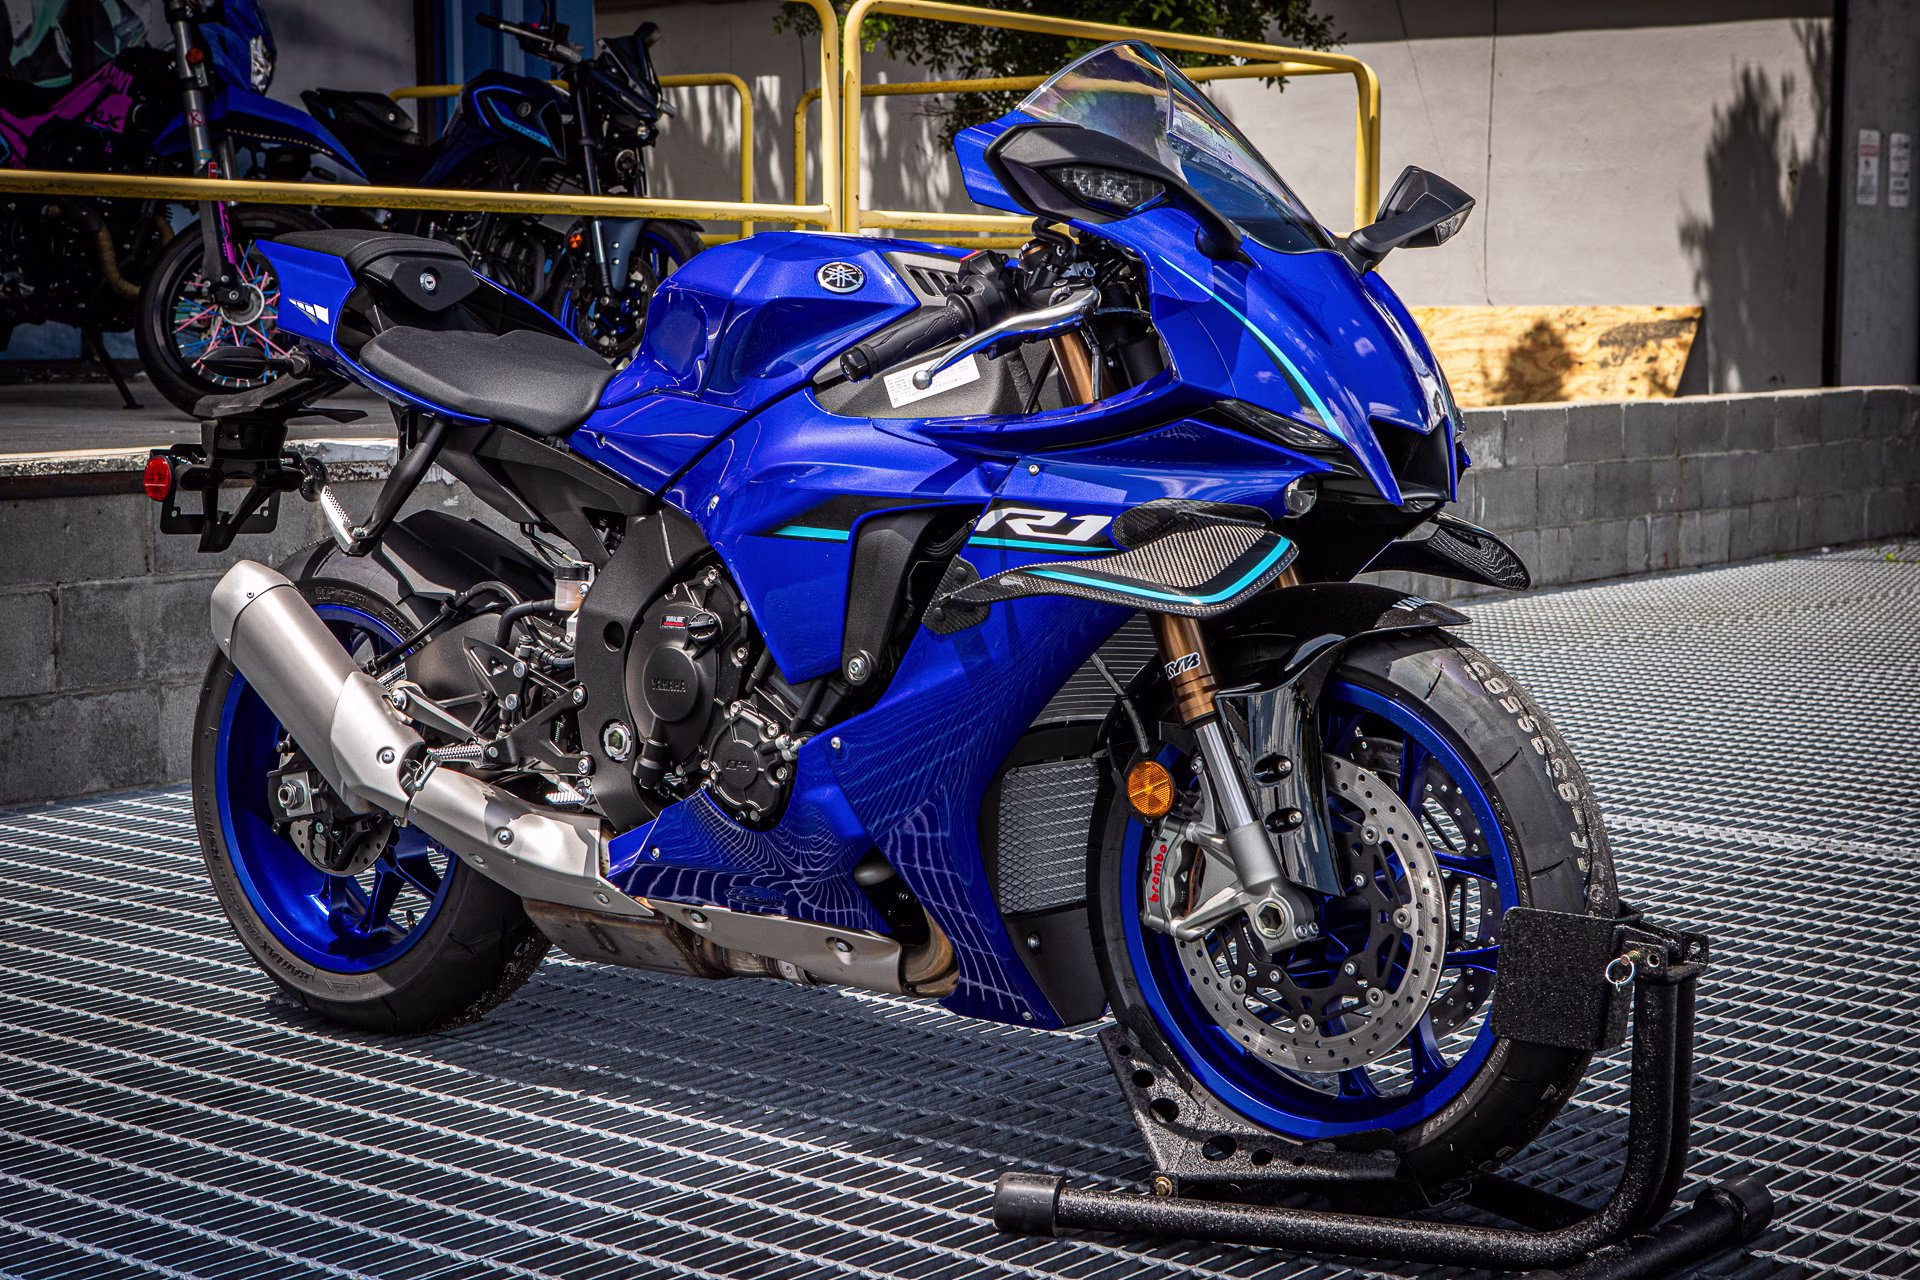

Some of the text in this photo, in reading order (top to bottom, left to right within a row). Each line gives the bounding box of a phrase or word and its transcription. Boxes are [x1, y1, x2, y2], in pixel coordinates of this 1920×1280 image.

[975, 507, 1112, 541] R1
[1164, 651, 1200, 680] KYB
[651, 679, 686, 693] YAMAHA
[1148, 844, 1167, 903] brembo
